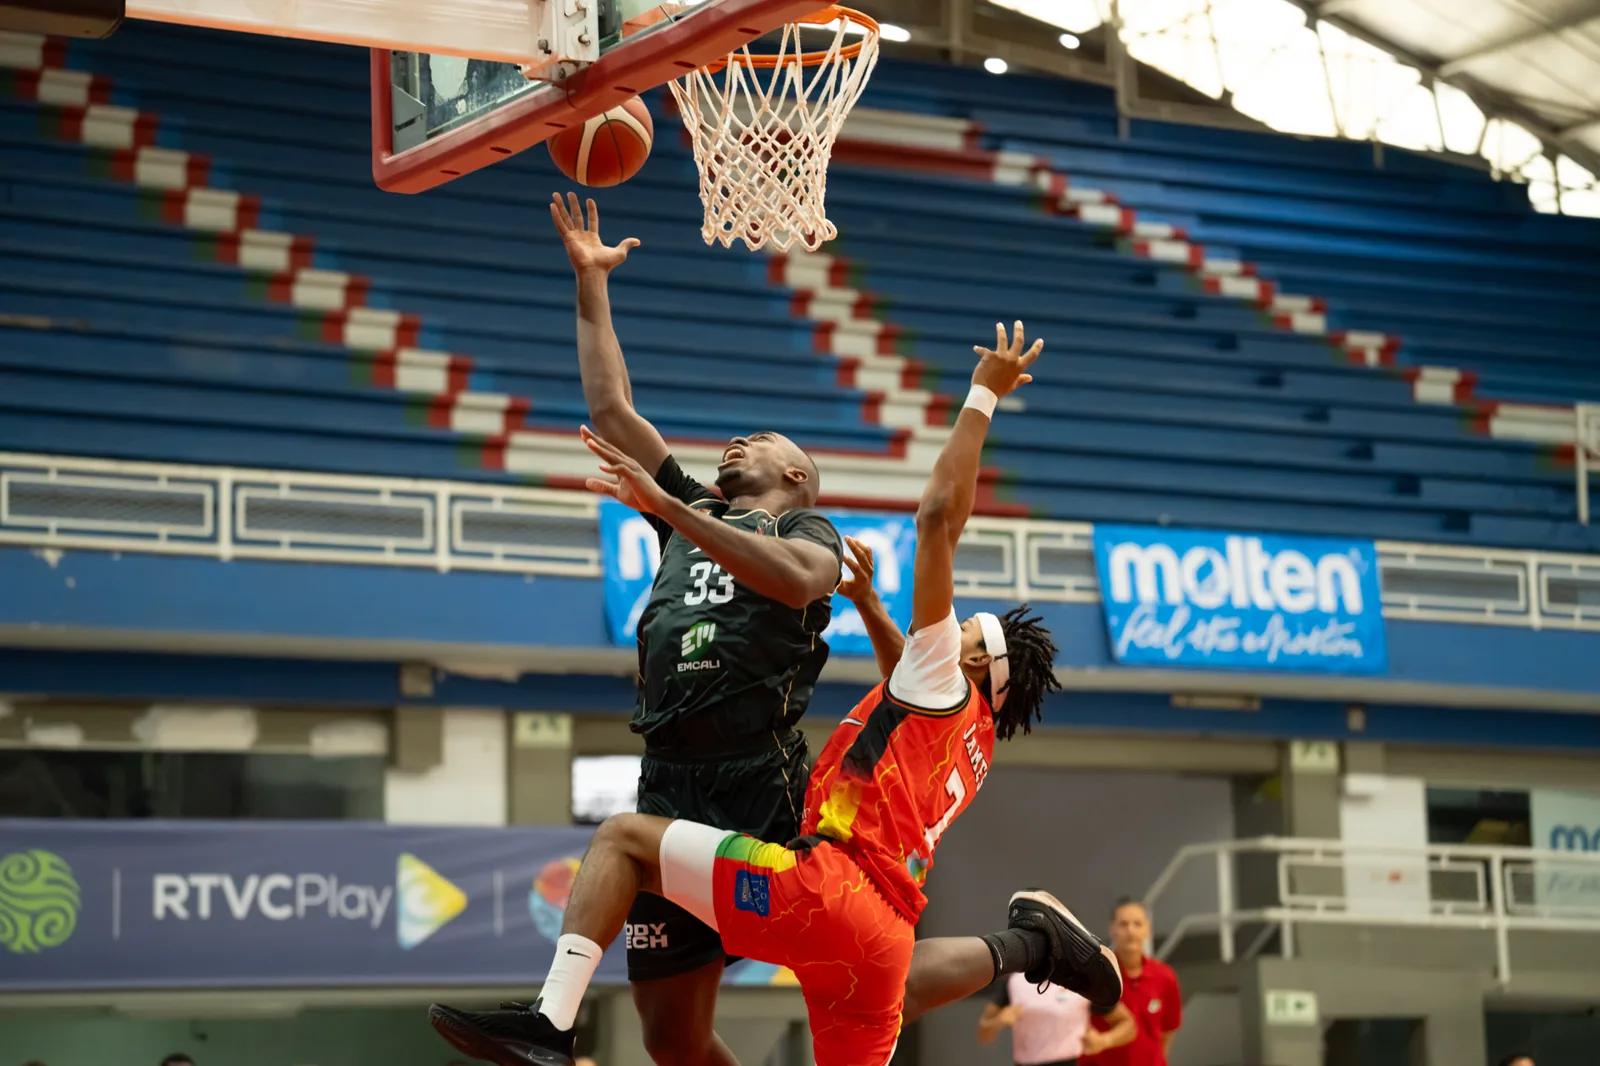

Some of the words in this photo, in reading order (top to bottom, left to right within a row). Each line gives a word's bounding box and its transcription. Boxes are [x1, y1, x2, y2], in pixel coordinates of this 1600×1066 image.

[684, 561, 735, 606] 33
[1108, 535, 1364, 615] molten
[677, 659, 720, 672] EMCALI
[153, 873, 392, 930] RTVCPlay
[625, 922, 667, 936] ODY
[625, 934, 669, 949] ECH
